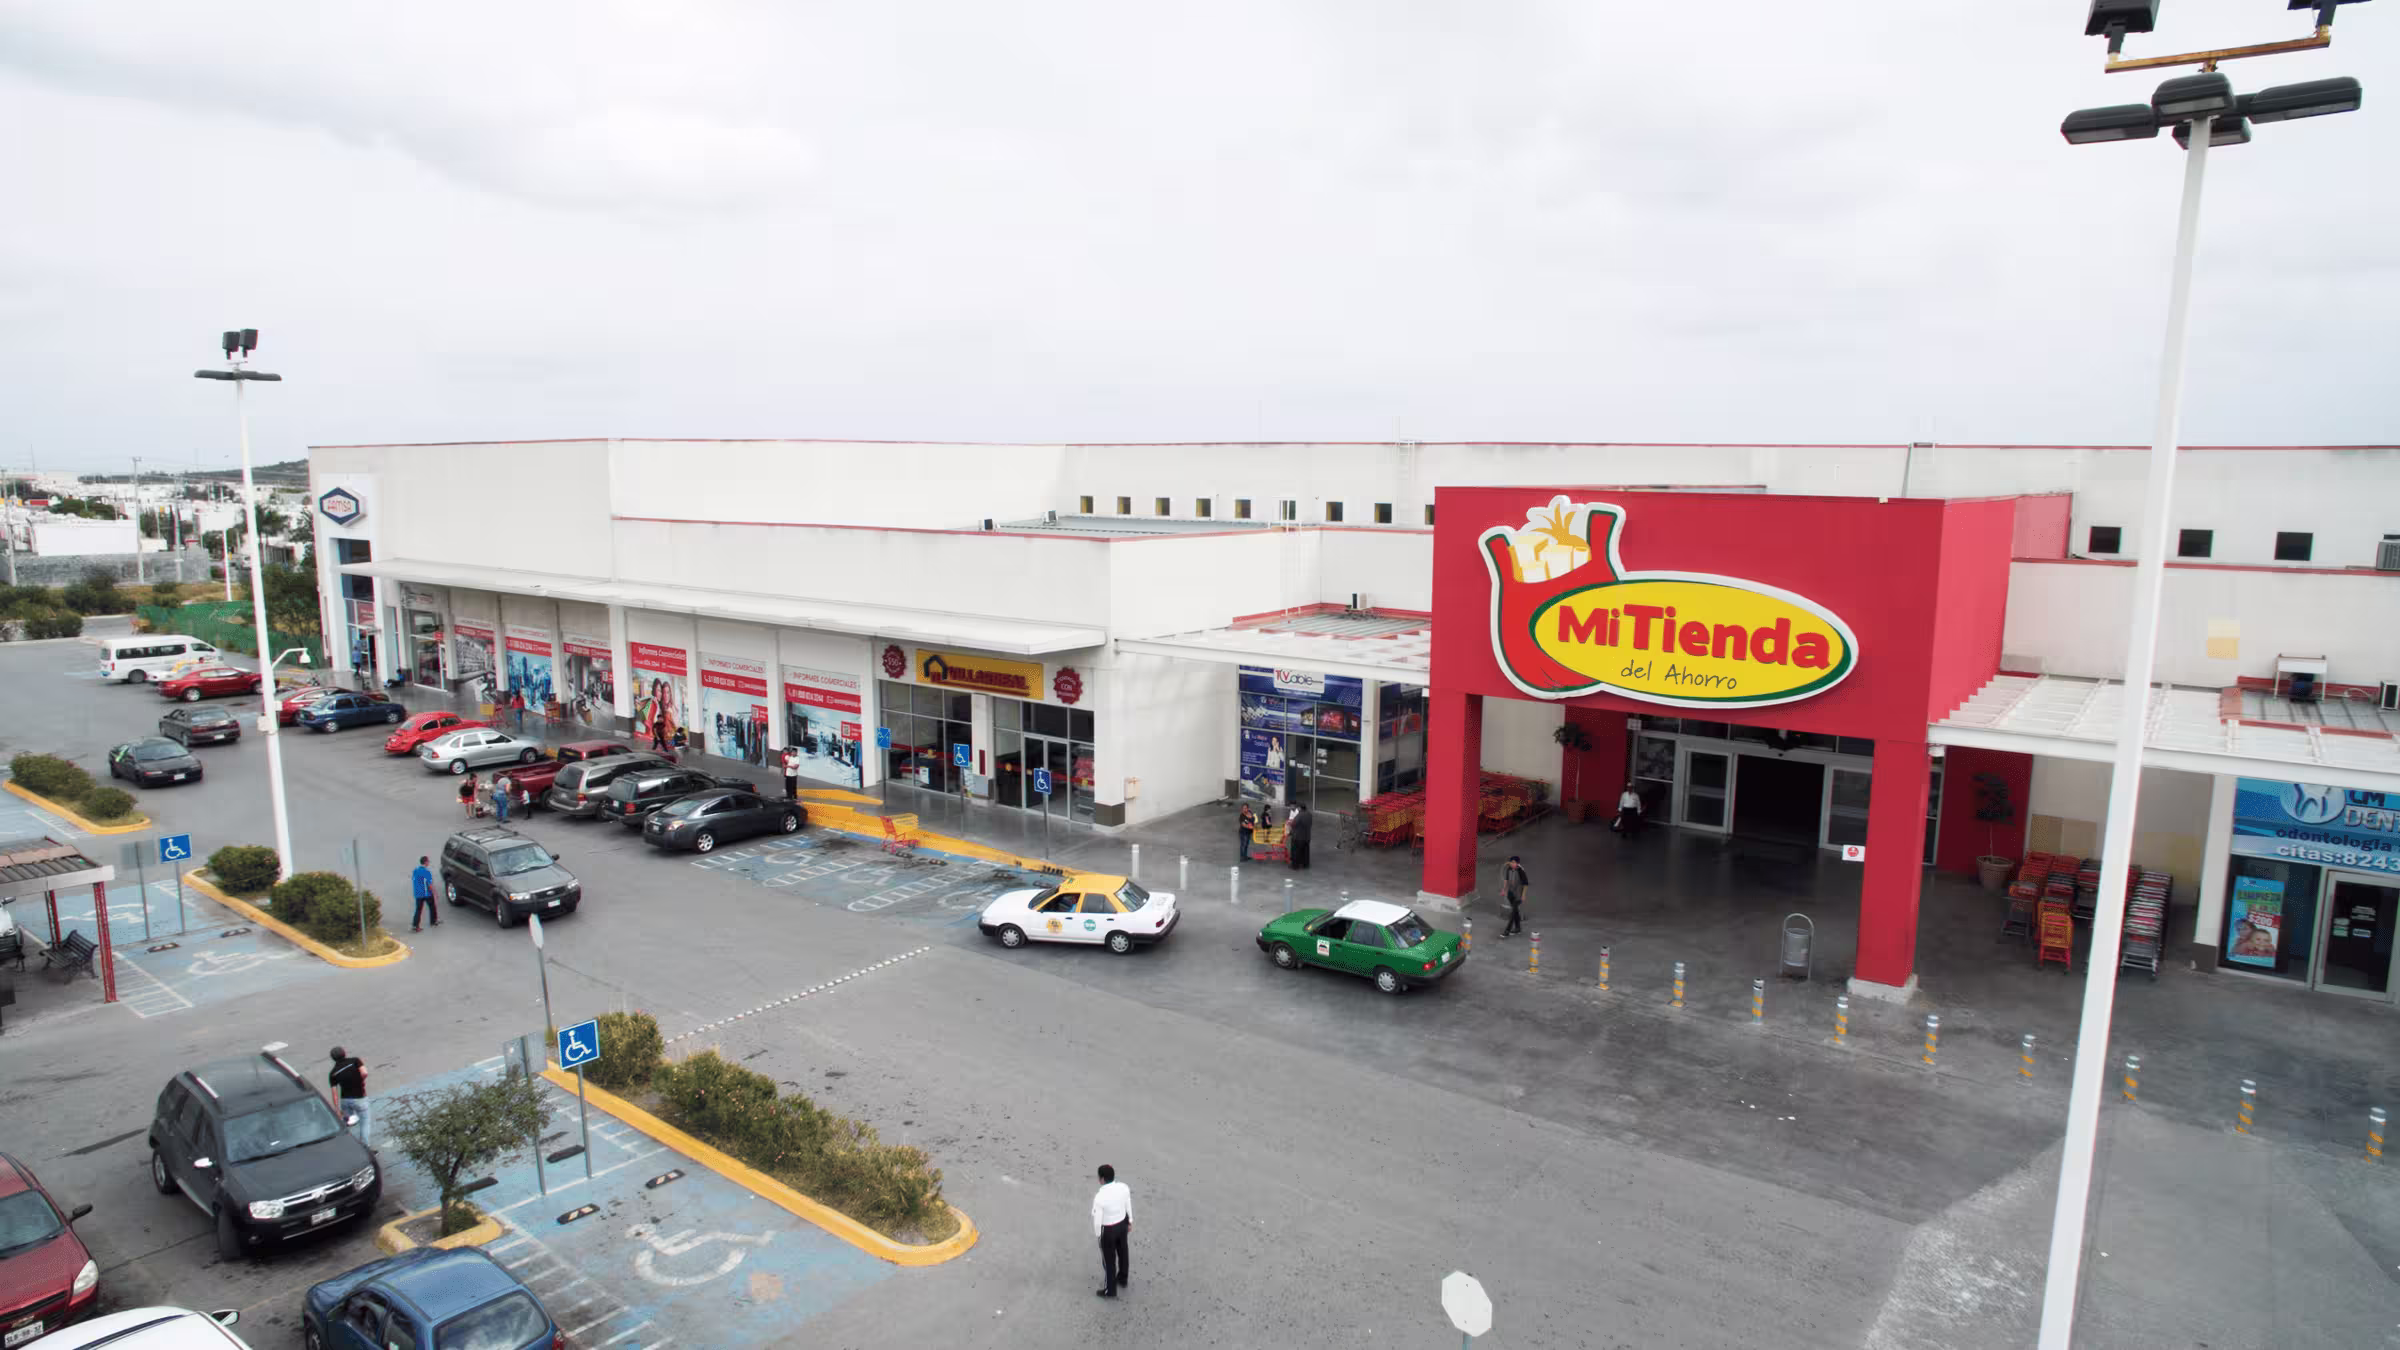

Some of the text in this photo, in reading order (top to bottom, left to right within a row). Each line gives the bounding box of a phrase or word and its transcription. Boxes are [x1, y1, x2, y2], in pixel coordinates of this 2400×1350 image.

[1558, 604, 1831, 670] MiTienda
[793, 671, 858, 689] INFORMES COMERCIALES
[1620, 659, 1737, 690] del Ahorro
